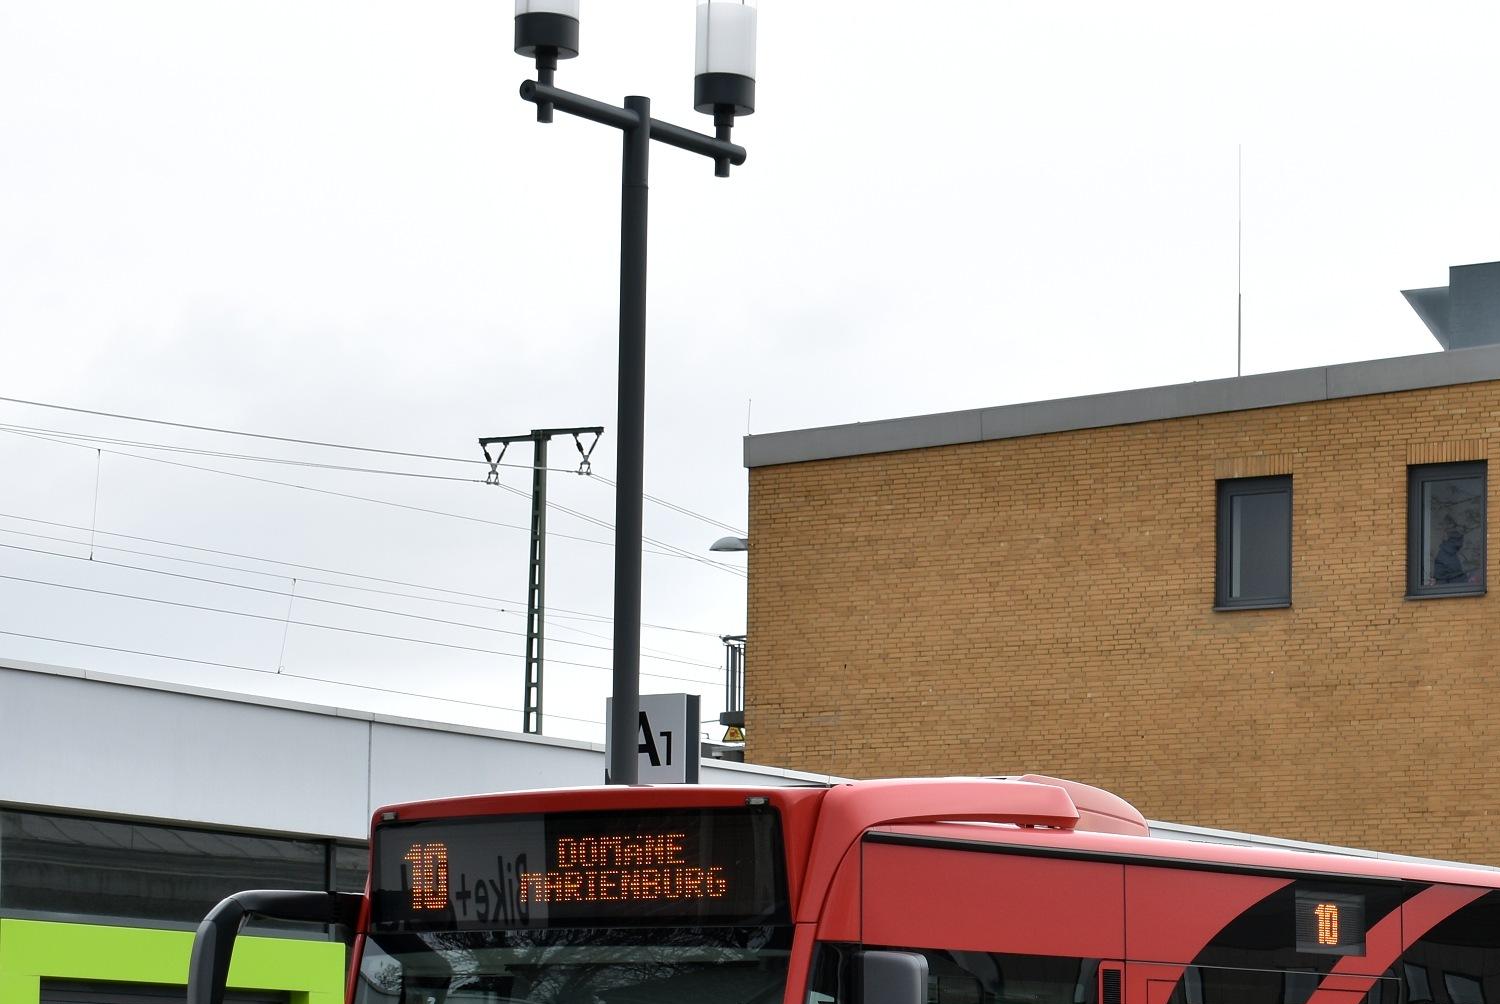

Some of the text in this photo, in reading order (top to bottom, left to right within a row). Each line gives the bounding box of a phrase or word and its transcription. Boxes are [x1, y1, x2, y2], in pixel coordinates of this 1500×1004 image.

[404, 842, 448, 909] 10
[520, 866, 727, 902] MARIENBURG
[1314, 903, 1338, 945] 10
